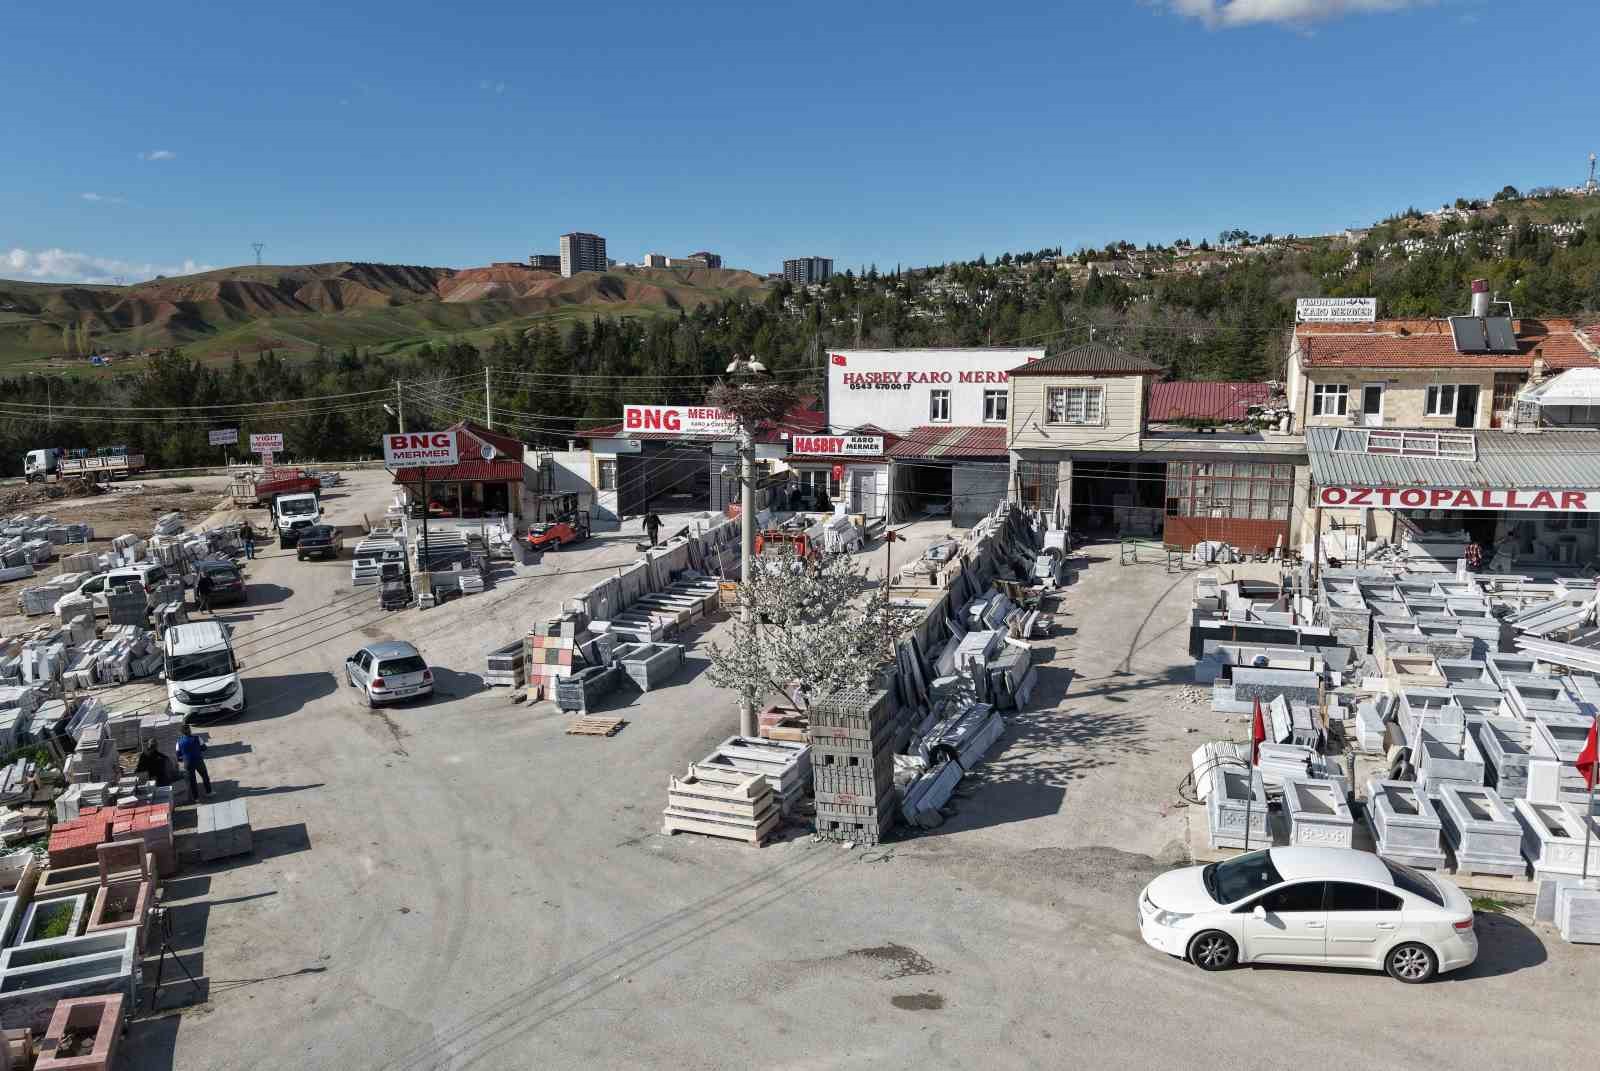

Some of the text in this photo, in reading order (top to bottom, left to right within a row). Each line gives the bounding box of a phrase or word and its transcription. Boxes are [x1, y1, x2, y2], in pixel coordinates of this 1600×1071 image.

[843, 371, 903, 385] HASBEY
[906, 371, 953, 384] KARO
[627, 408, 680, 430] BNG
[390, 434, 450, 449] BNG
[795, 437, 845, 452] HASBEY
[393, 449, 450, 459] MERMER
